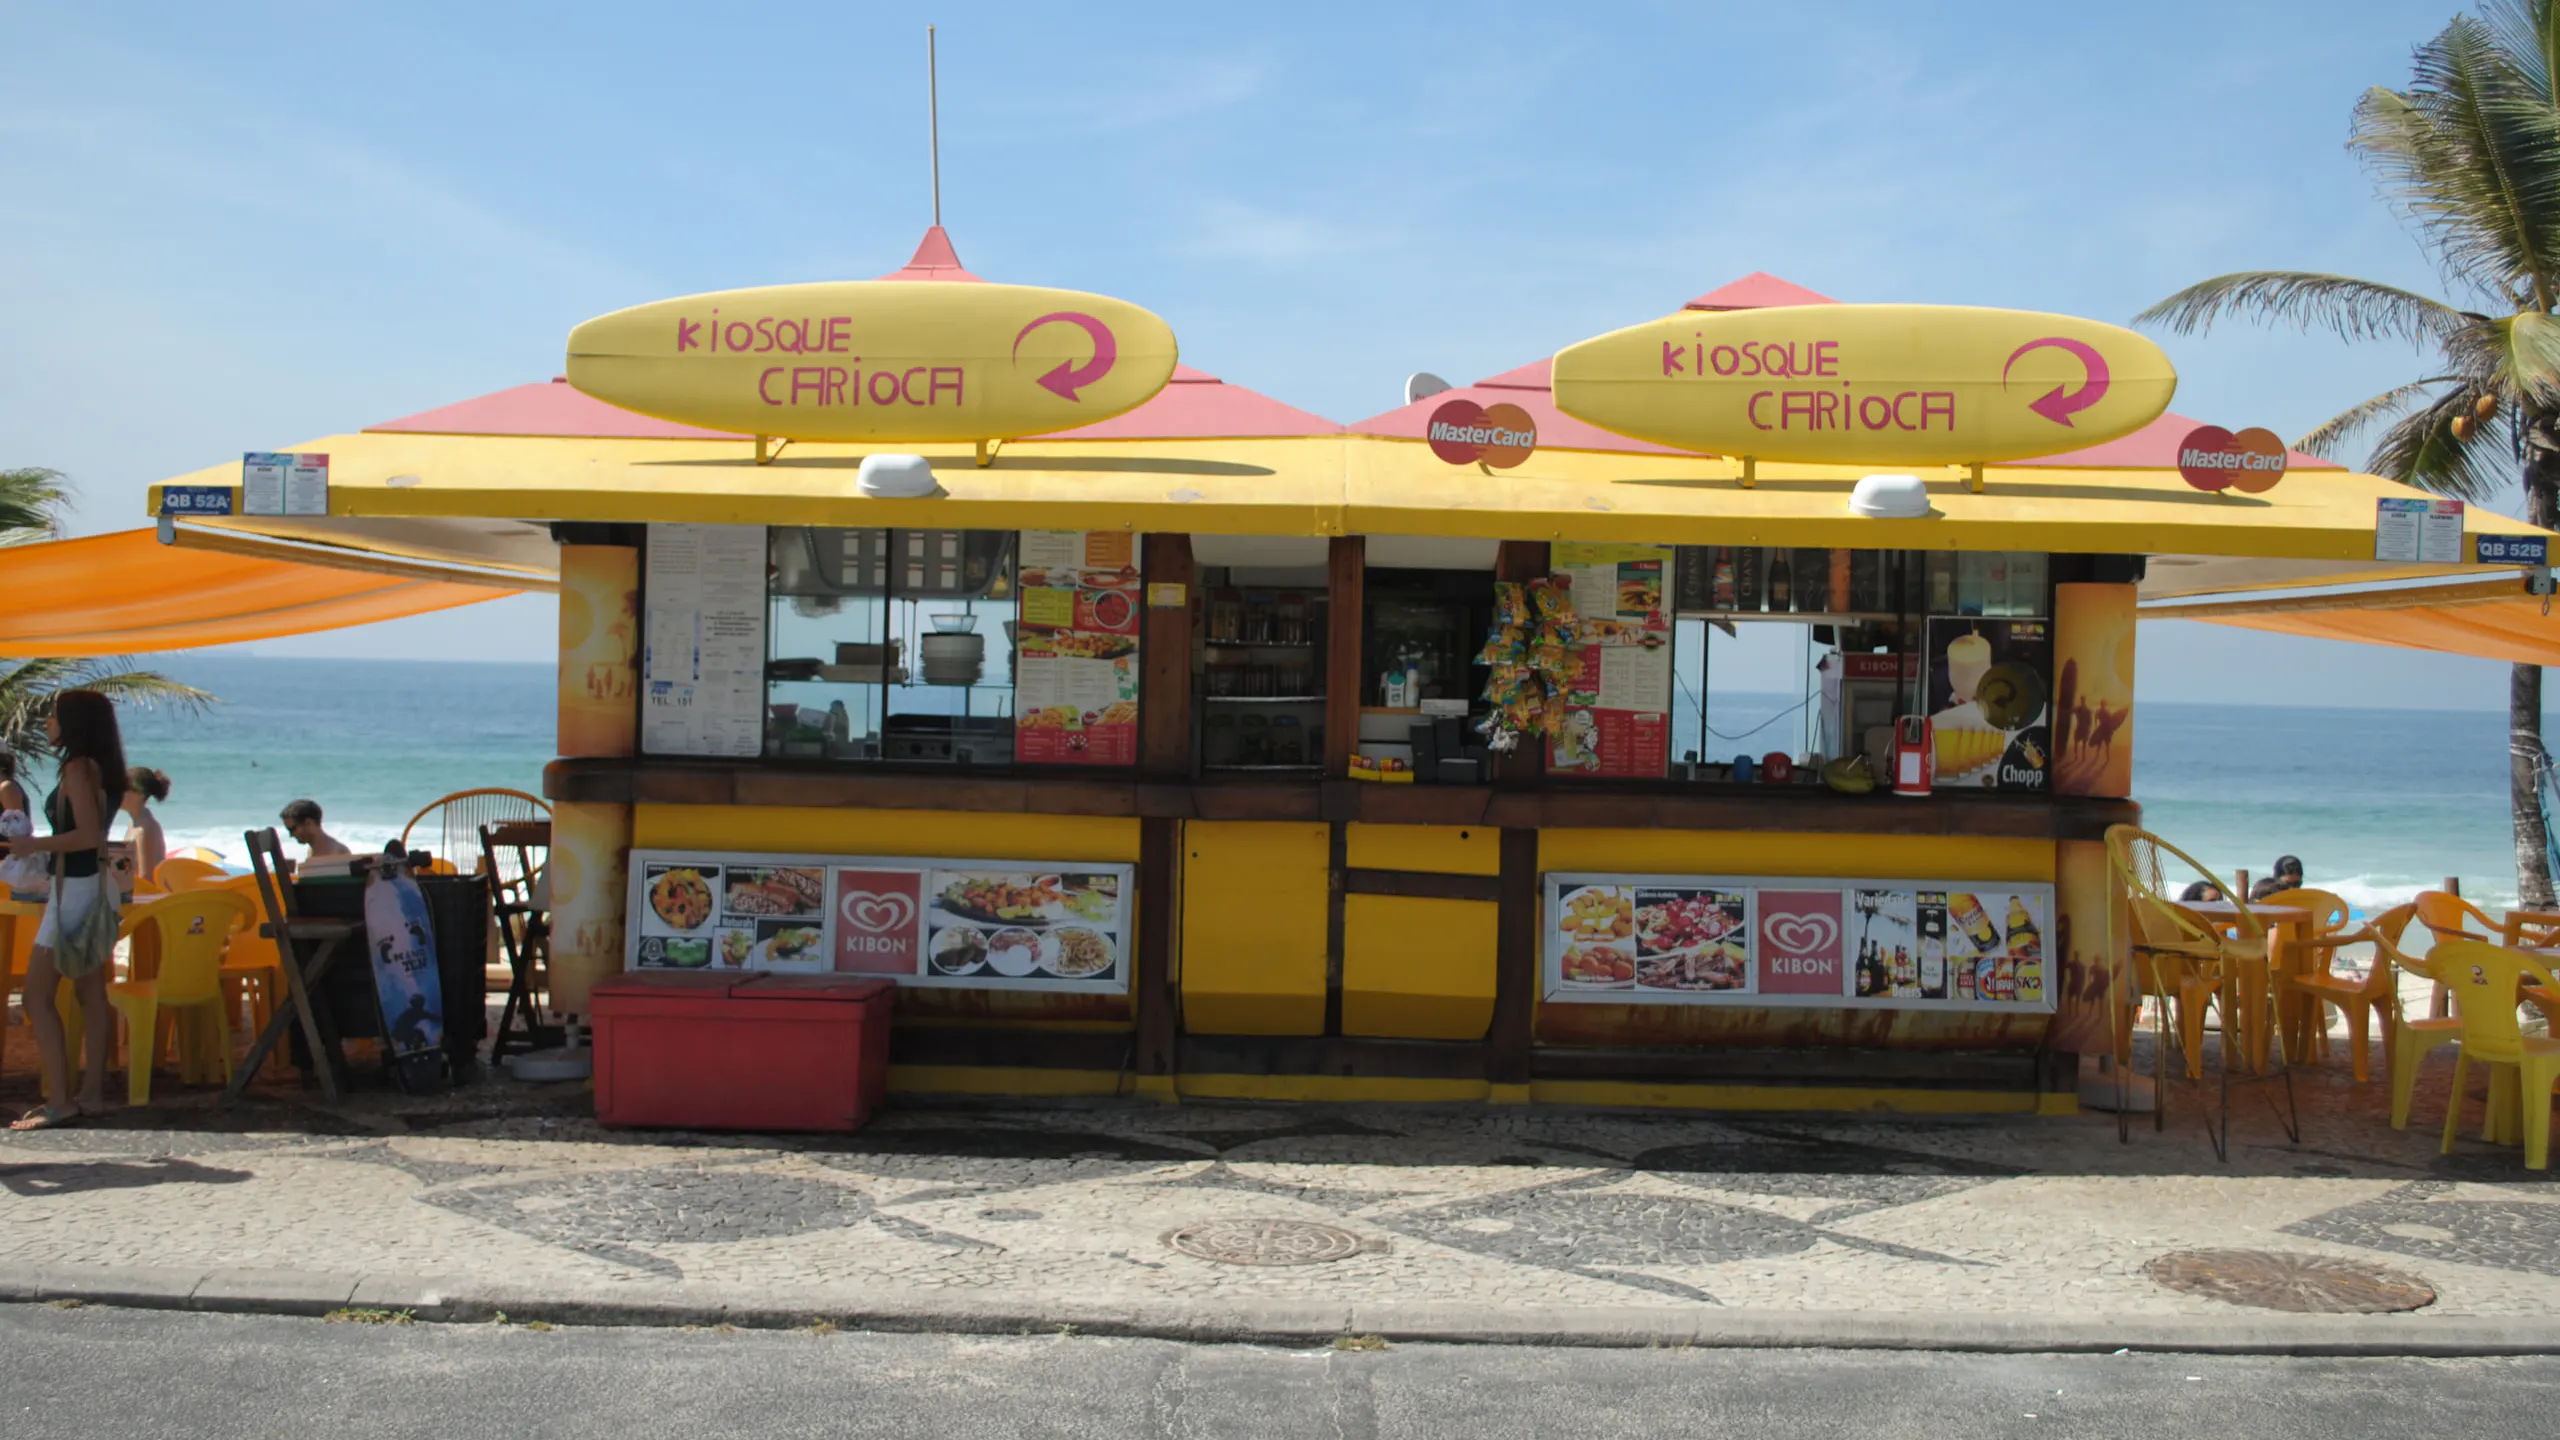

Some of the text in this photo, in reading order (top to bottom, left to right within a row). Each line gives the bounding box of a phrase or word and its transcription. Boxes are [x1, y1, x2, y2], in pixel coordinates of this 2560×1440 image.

[1429, 421, 1535, 449] MasterCard
[2180, 448, 2286, 471] MasterCard
[166, 494, 229, 509] QB 52A
[2479, 542, 2543, 557] QB 52B
[1860, 660, 1898, 672] KIBON
[2001, 764, 2044, 788] Chopp
[845, 934, 907, 954] KIBON
[1771, 956, 1833, 975] KIBON
